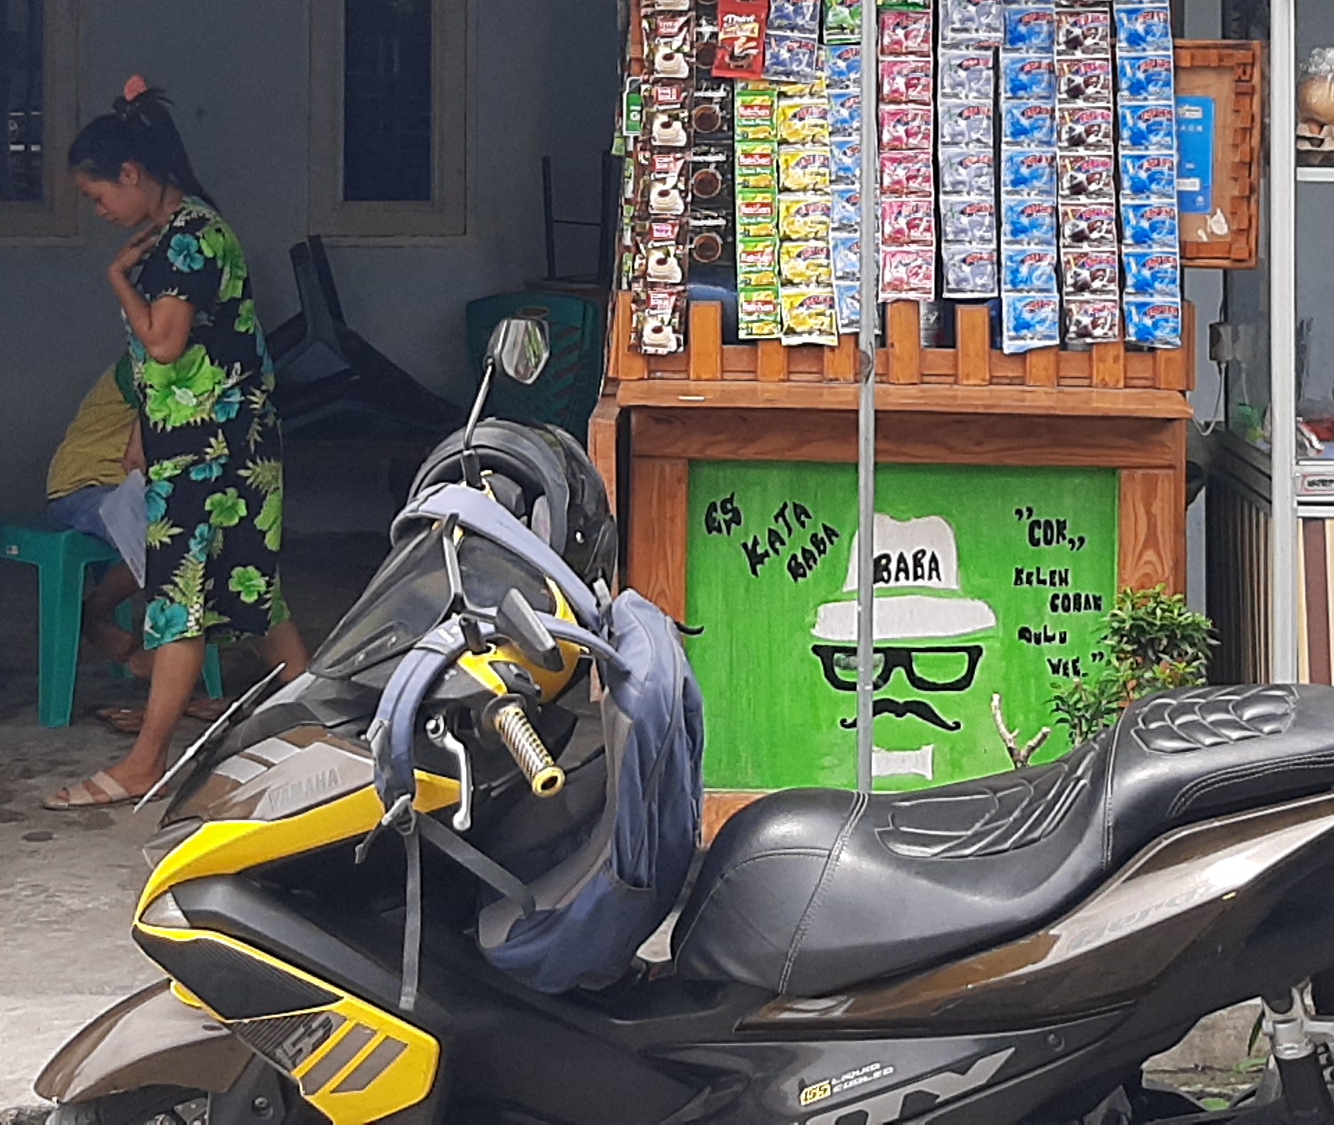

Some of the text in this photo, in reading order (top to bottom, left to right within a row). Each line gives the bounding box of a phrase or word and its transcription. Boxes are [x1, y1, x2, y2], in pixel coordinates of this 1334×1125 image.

[705, 492, 742, 536] ES
[741, 502, 812, 577] KATA
[787, 523, 839, 582] BABA
[873, 549, 942, 584] BABA
[267, 766, 340, 811] YAMAHA
